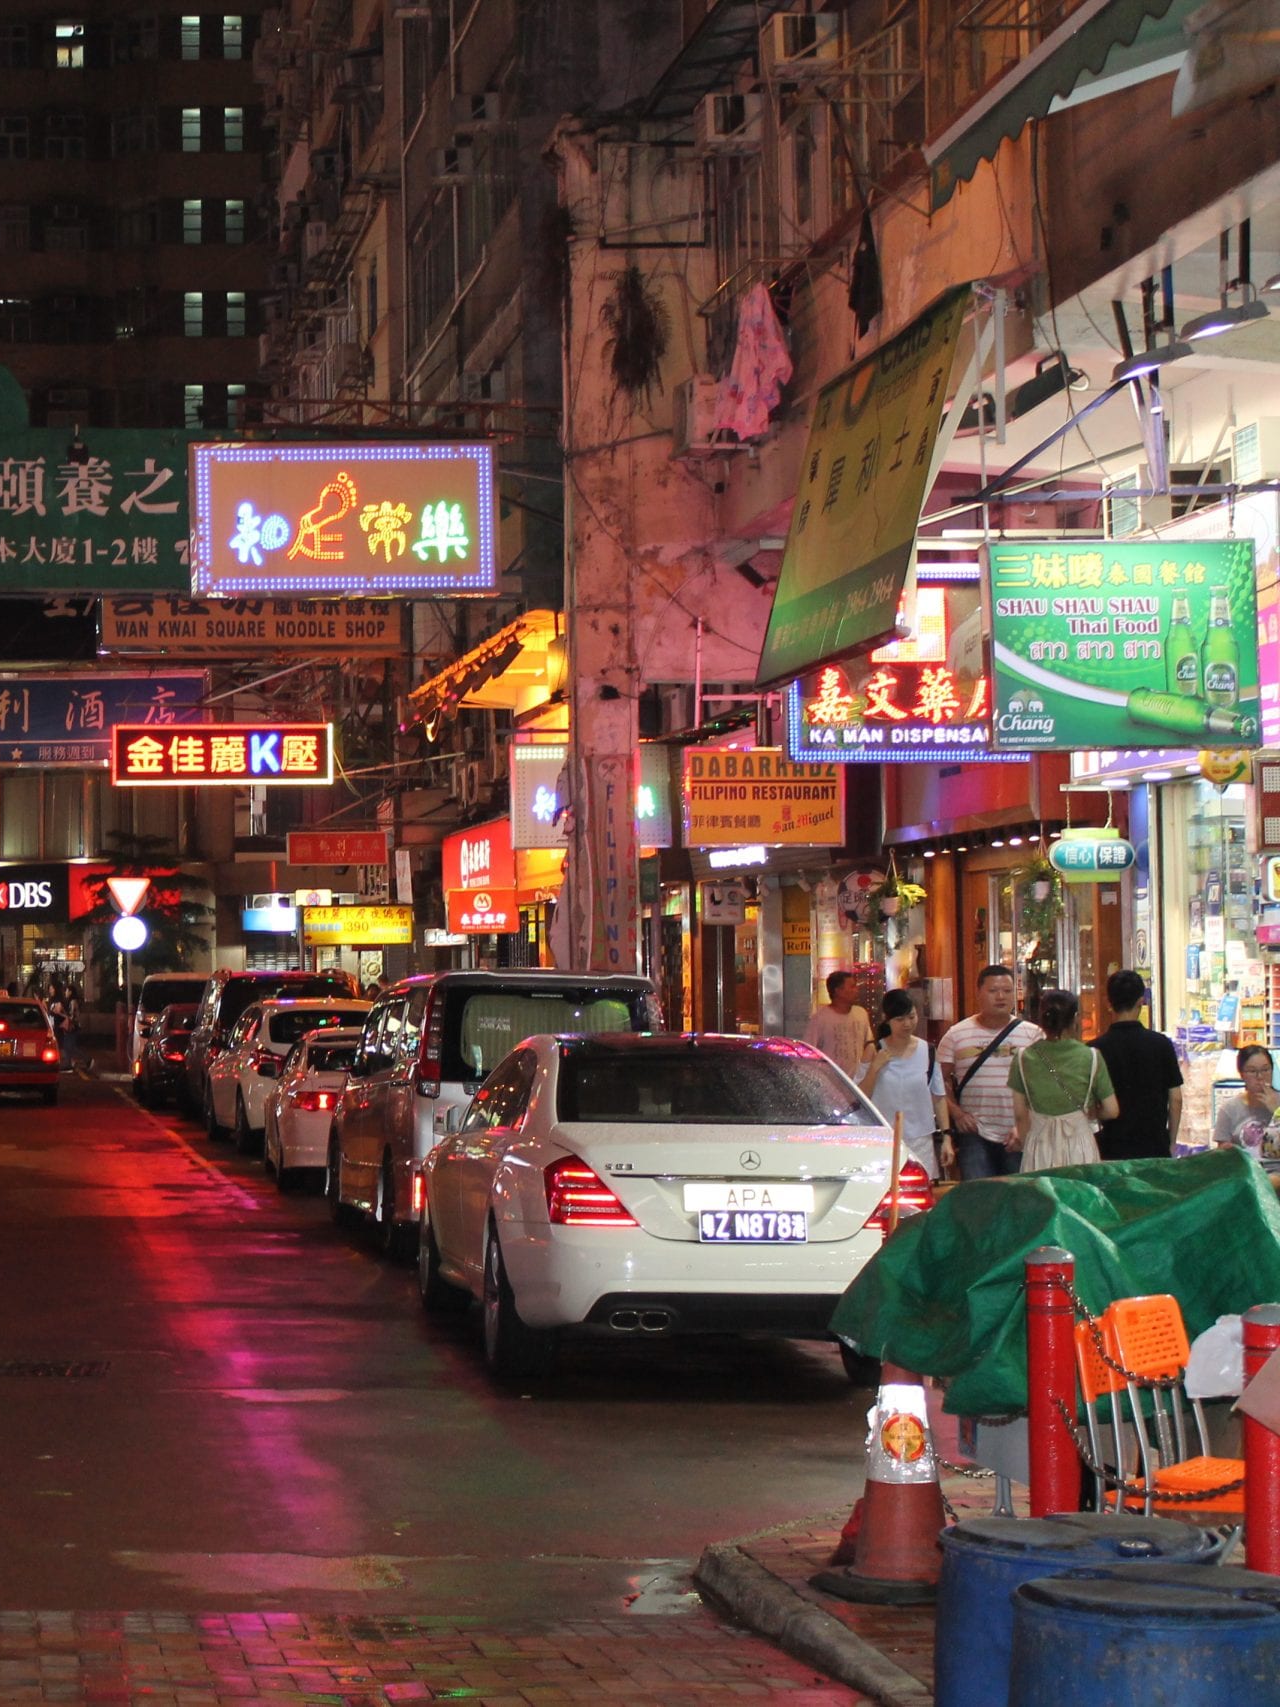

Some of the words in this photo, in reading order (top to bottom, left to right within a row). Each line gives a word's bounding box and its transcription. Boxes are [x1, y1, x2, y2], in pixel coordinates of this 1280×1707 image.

[996, 599, 1047, 616] SHAU
[1054, 598, 1103, 615] SHAU
[1109, 597, 1159, 615] SHAU
[115, 621, 148, 638] WAN
[158, 621, 196, 638] KWAI
[206, 621, 265, 638] SQUARE
[275, 620, 335, 637] NOODLE
[346, 620, 385, 637] SHOP
[1068, 617, 1108, 635] Thai
[1114, 617, 1159, 634] Food
[999, 714, 1055, 733] Chang
[810, 728, 835, 743] KA
[843, 728, 882, 743] MAN
[891, 728, 988, 743] DISPENSA
[692, 786, 746, 800] FILIPINO
[752, 786, 836, 800] RESTAURANT
[773, 819, 795, 833] San
[796, 805, 834, 829] Miguel
[8, 882, 52, 909] DBS
[791, 924, 810, 933] Foo
[727, 1189, 773, 1206] APA
